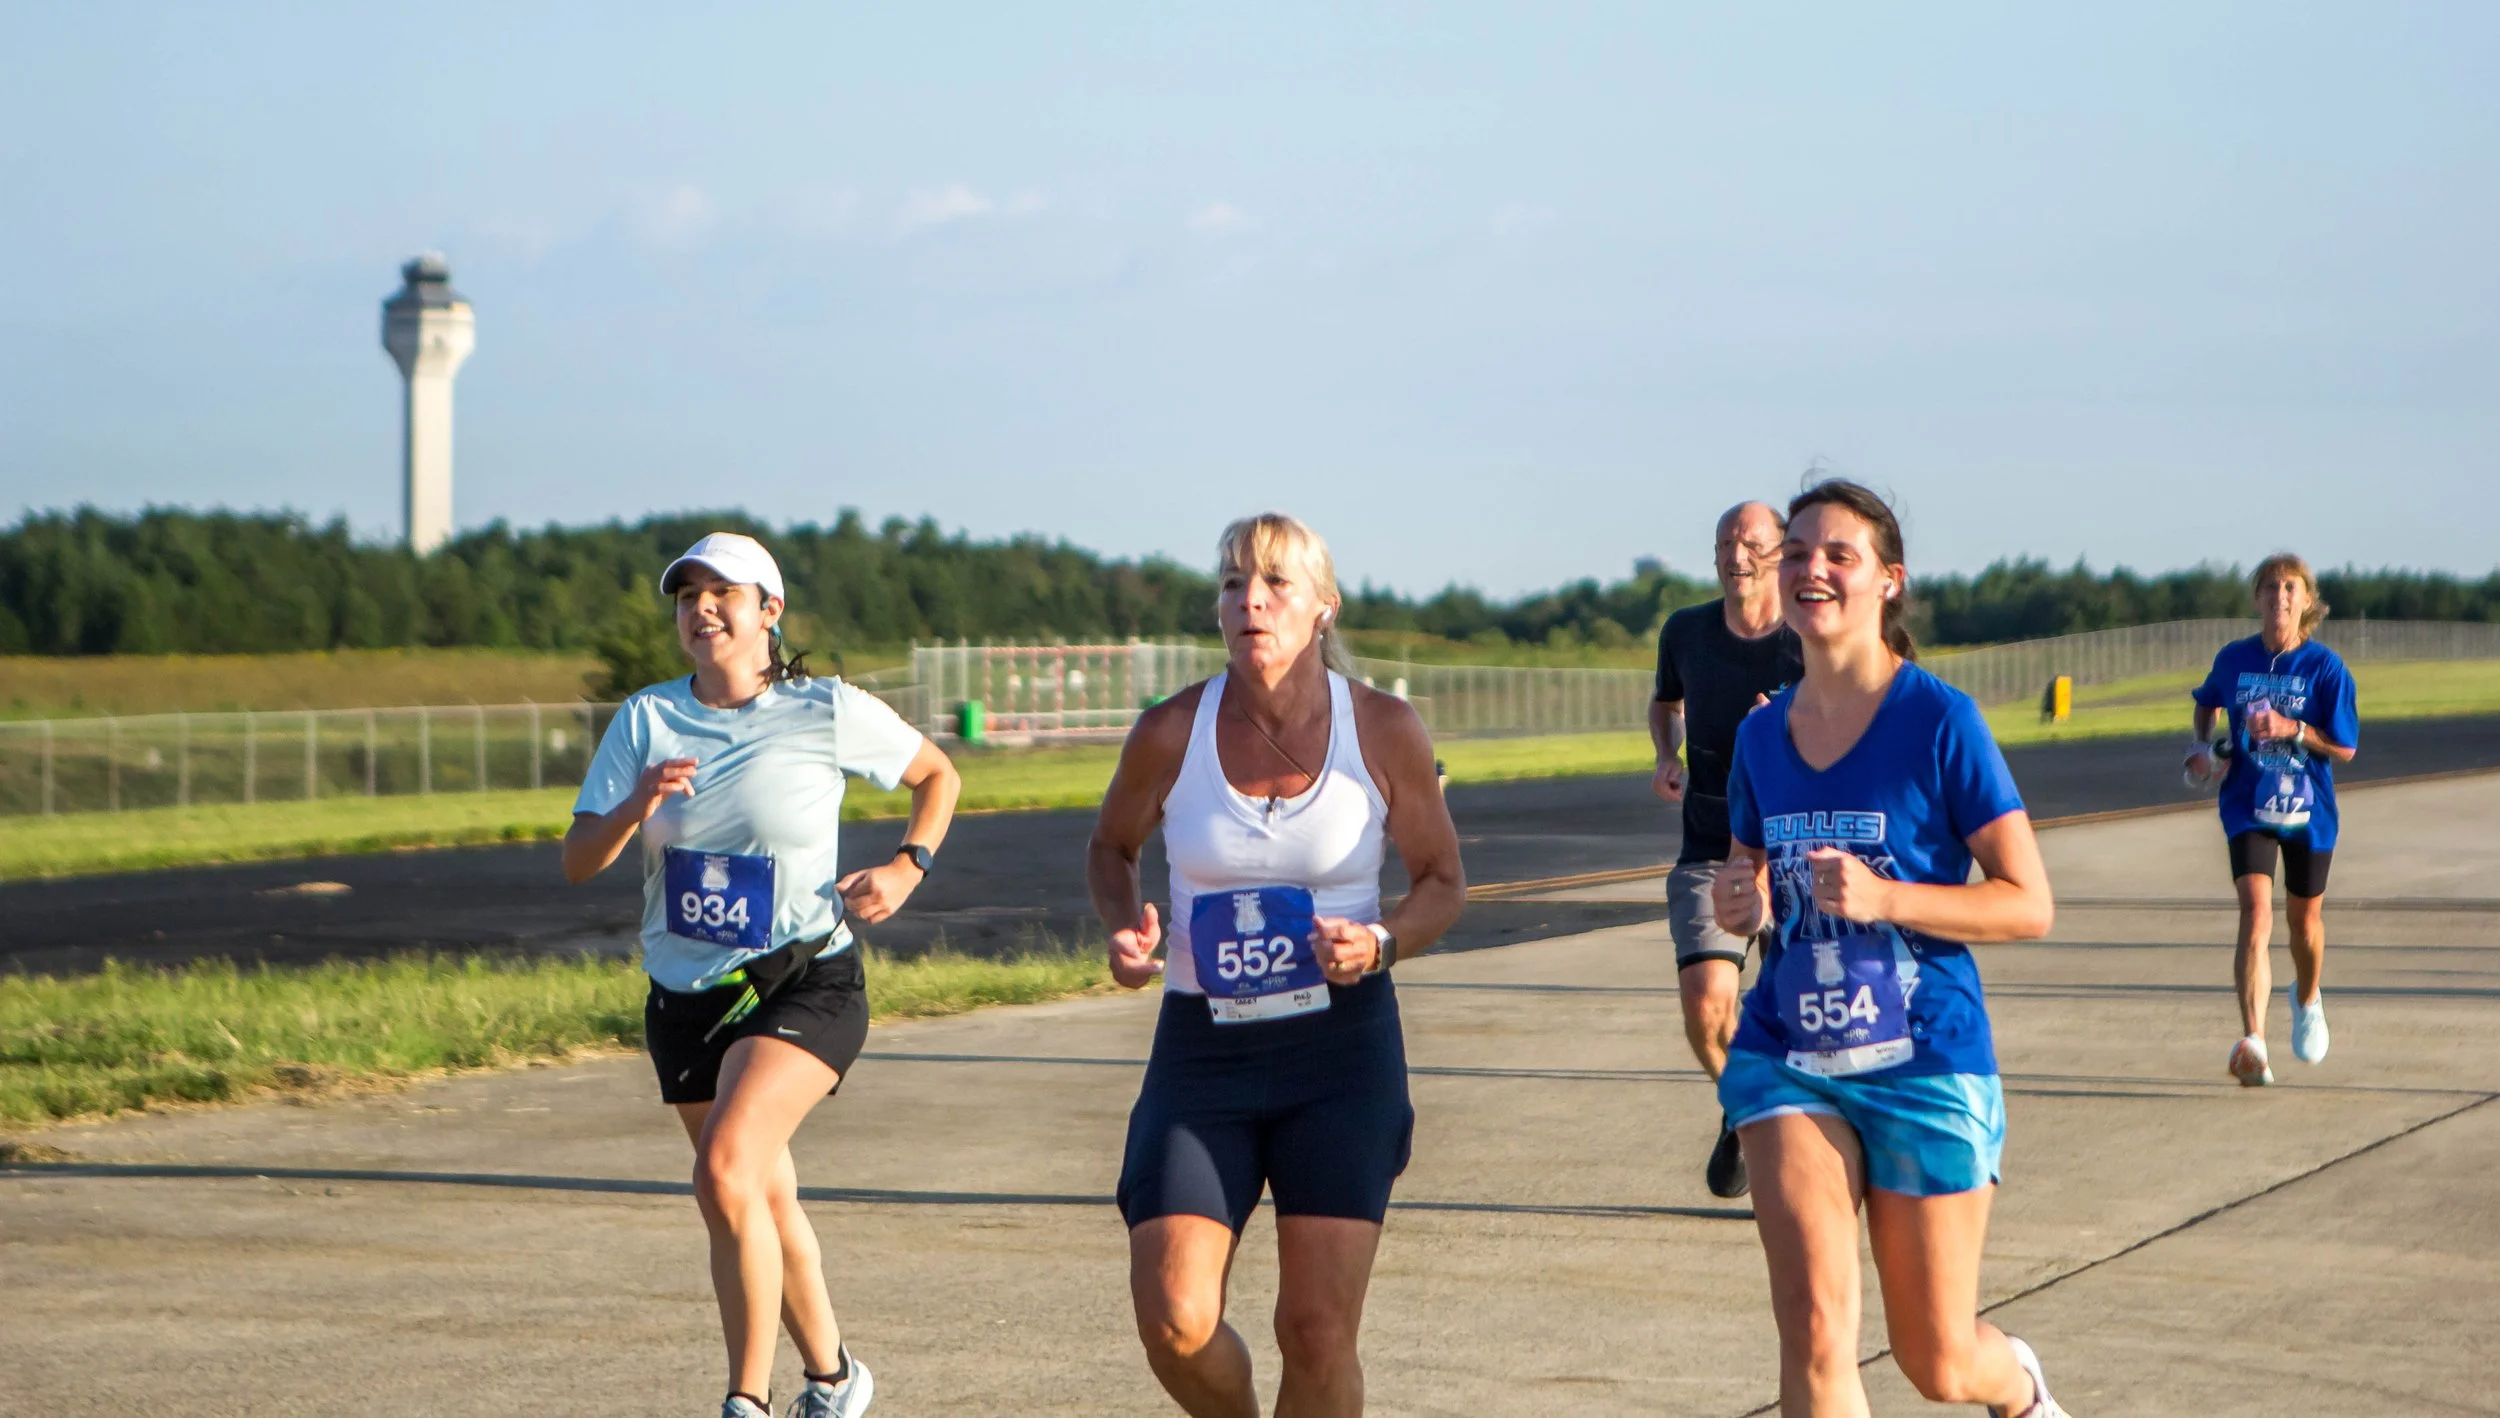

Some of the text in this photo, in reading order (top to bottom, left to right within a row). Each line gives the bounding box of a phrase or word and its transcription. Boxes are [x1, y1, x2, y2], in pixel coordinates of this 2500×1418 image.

[2264, 795, 2304, 814] 417
[1764, 812, 1884, 842] DULLES
[681, 891, 750, 929] 934
[1218, 936, 1297, 980] 552
[1800, 985, 1880, 1032] 554
